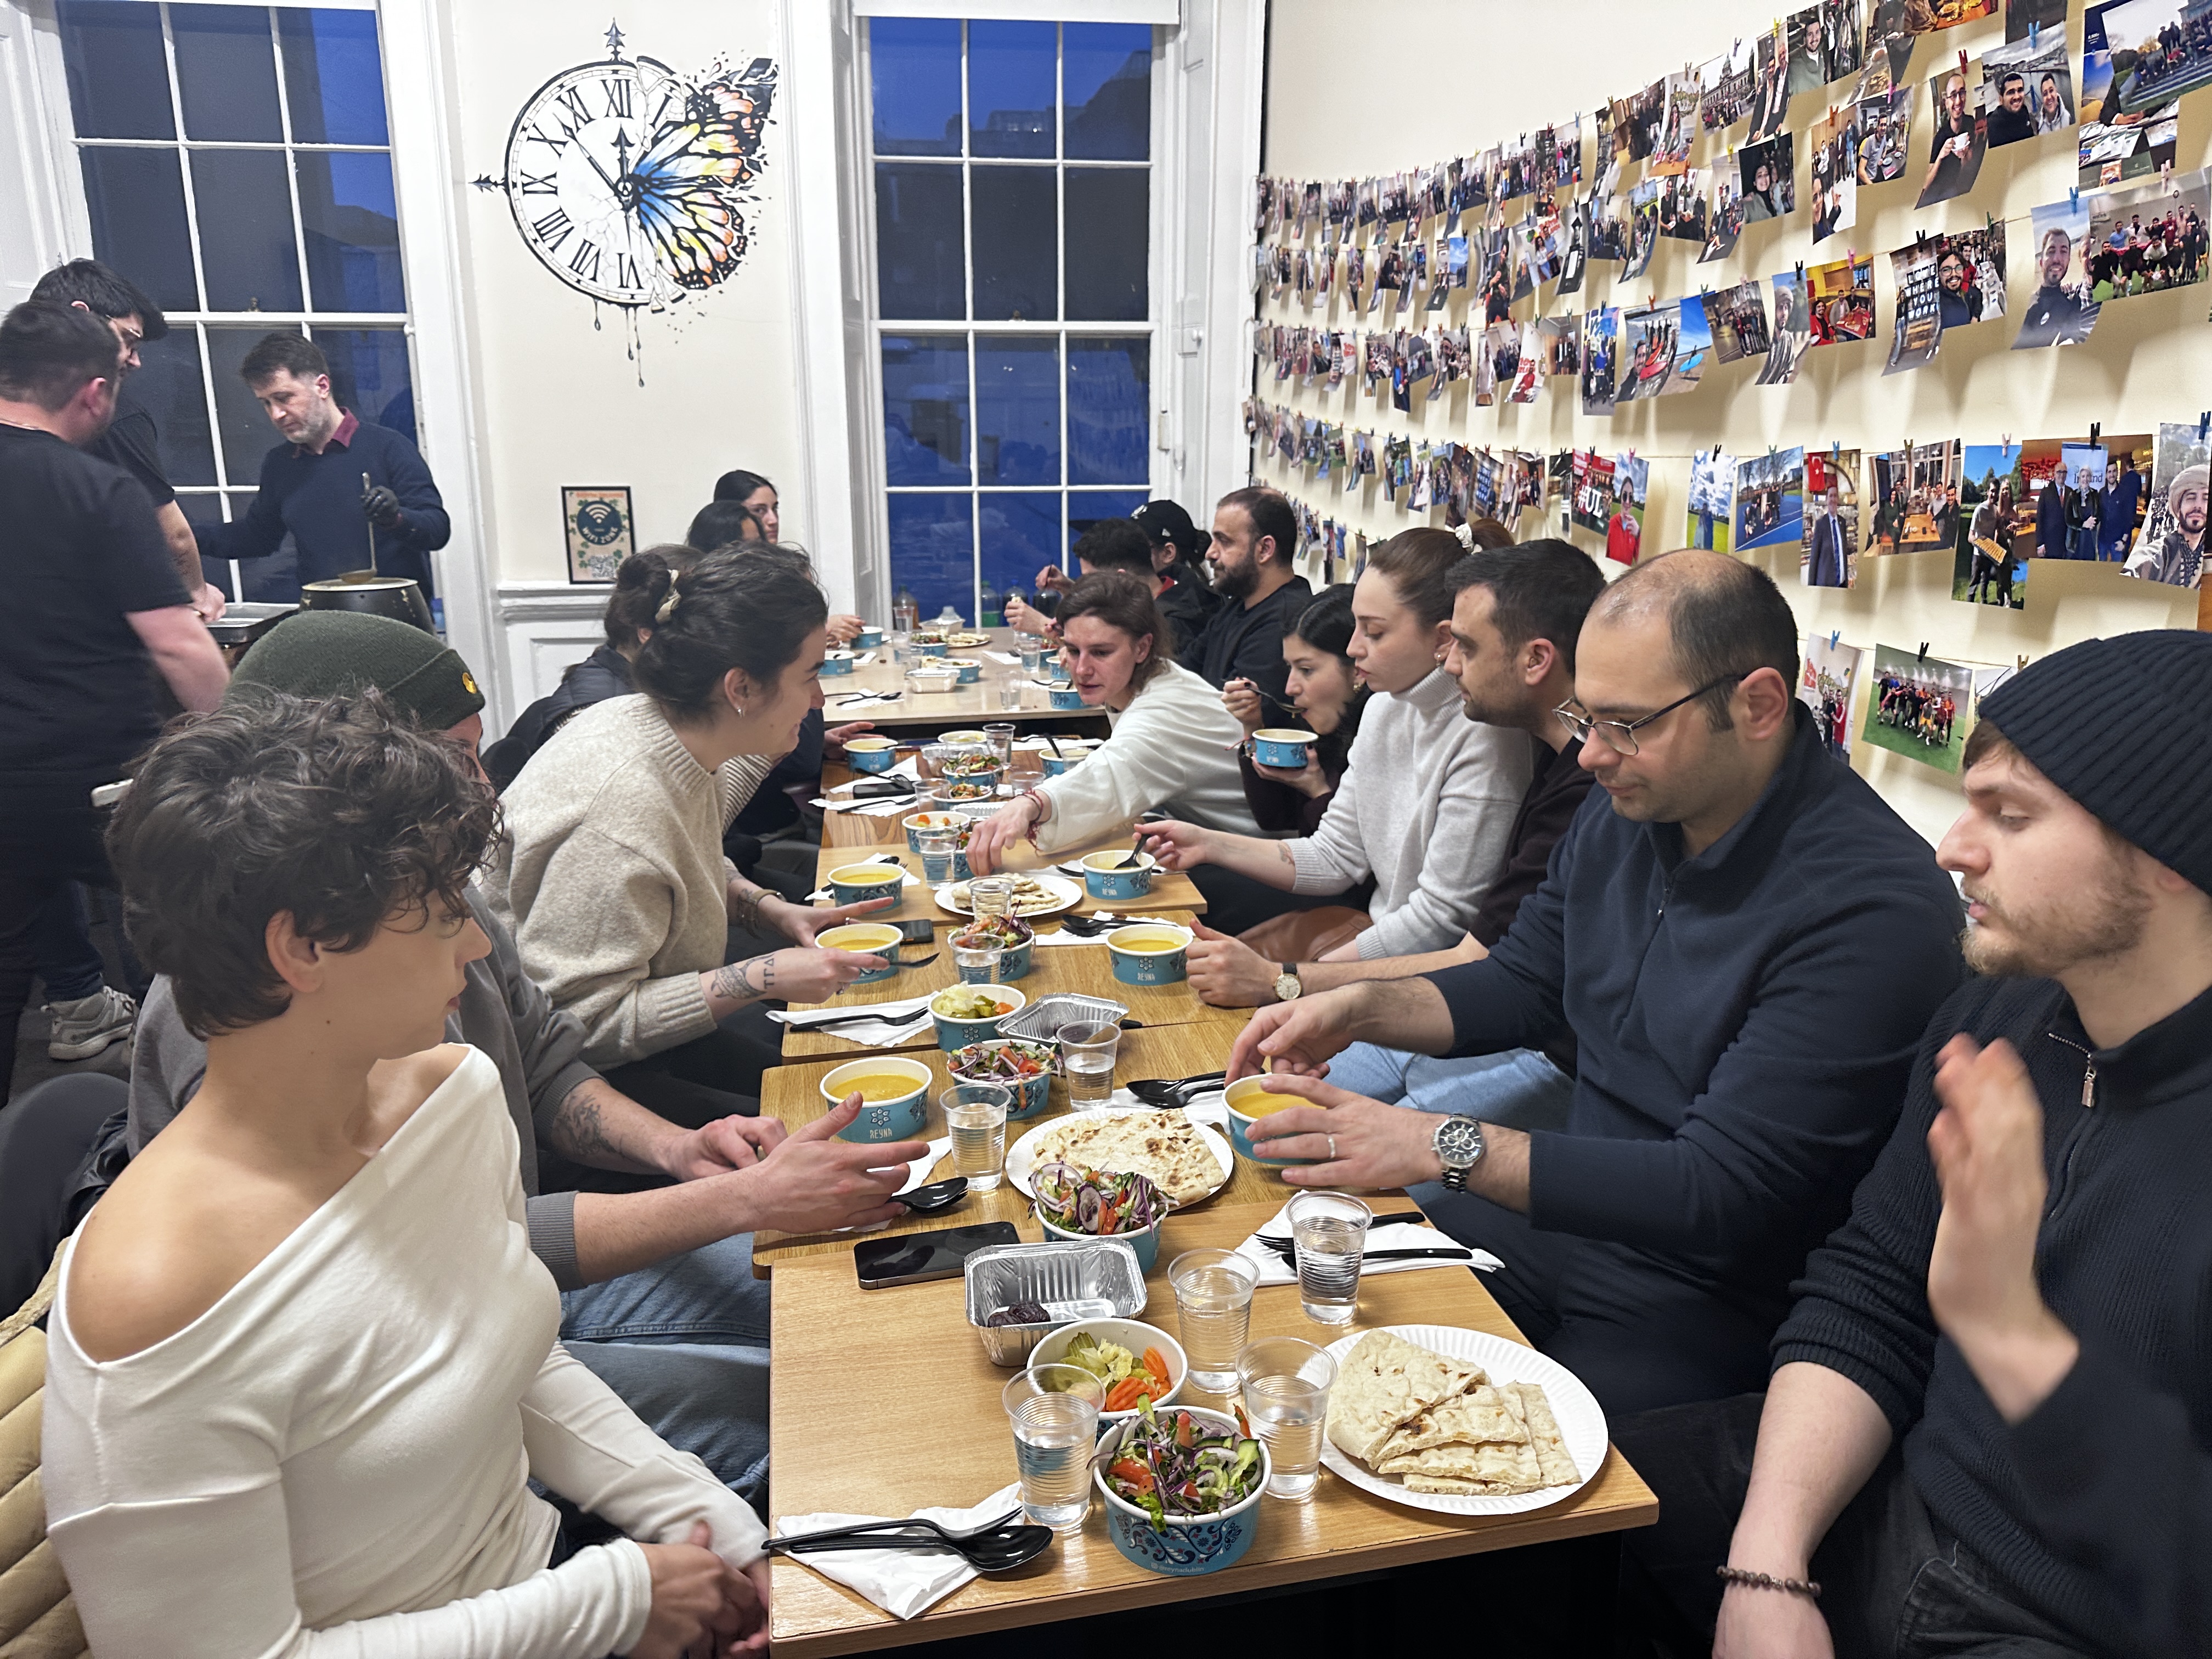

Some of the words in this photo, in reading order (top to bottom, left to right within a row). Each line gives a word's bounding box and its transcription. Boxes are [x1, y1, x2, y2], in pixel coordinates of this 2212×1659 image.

[554, 85, 597, 133] XI
[600, 79, 634, 119] XII
[527, 122, 569, 160] X
[521, 168, 558, 196] IX
[531, 205, 574, 254] VIII
[567, 238, 601, 283] VII
[616, 252, 644, 290] VI
[1905, 277, 1939, 297] WHERE
[1913, 292, 1933, 306] YOU
[1908, 303, 1936, 319] WORK
[1578, 484, 1602, 518] #UL
[1137, 972, 1155, 981] REYNA
[870, 1127, 893, 1139] REYNA
